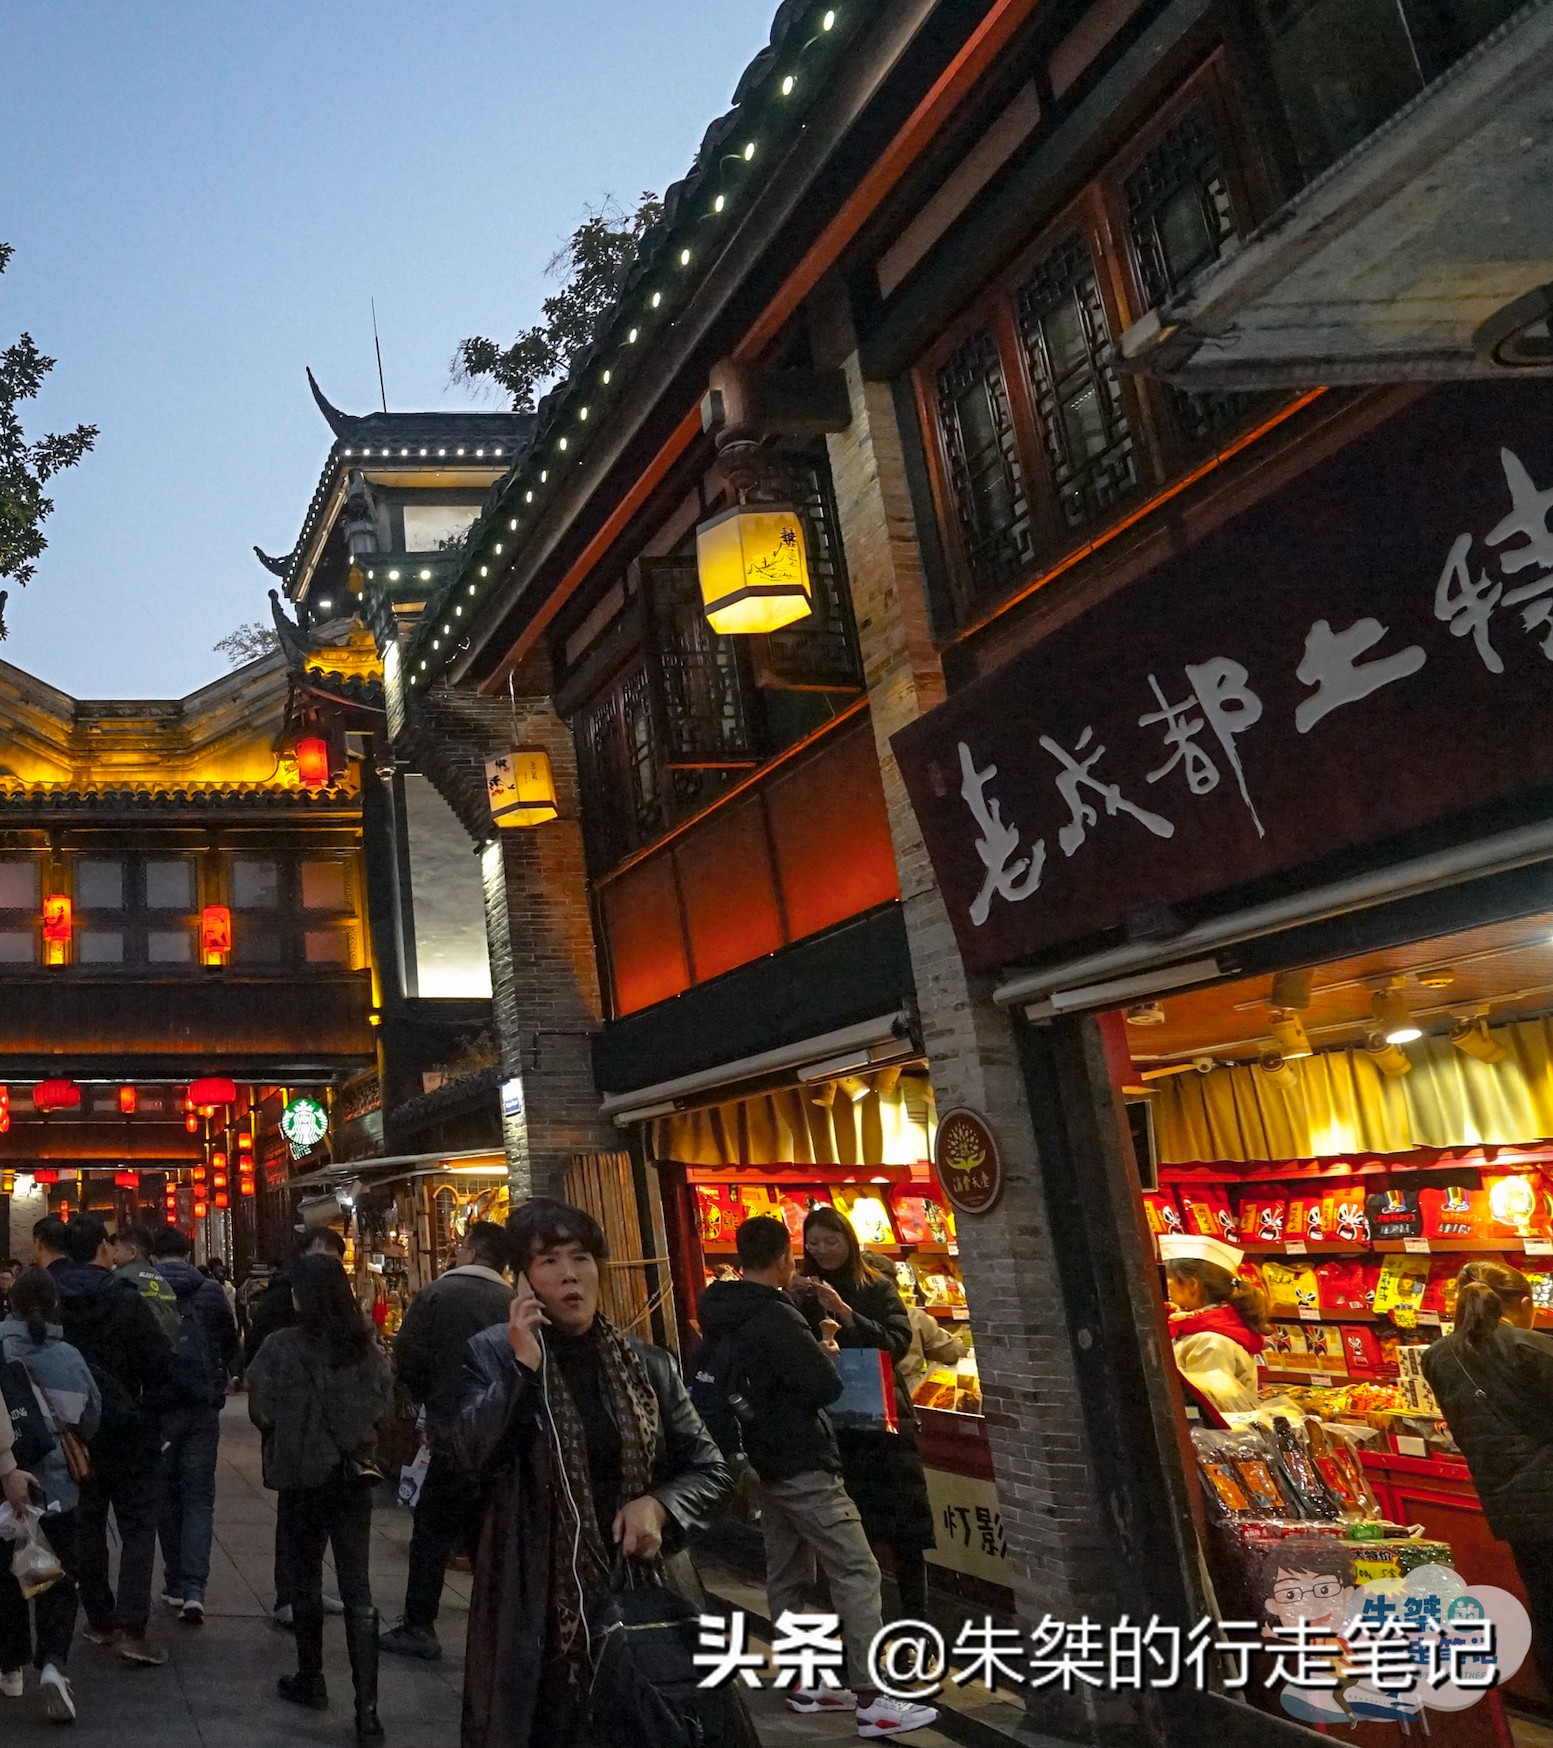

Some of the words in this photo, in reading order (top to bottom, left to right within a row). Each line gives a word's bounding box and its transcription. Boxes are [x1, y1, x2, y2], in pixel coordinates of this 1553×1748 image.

[943, 1505, 1007, 1560] 灯影
[1353, 1550, 1392, 1562] 大特价
